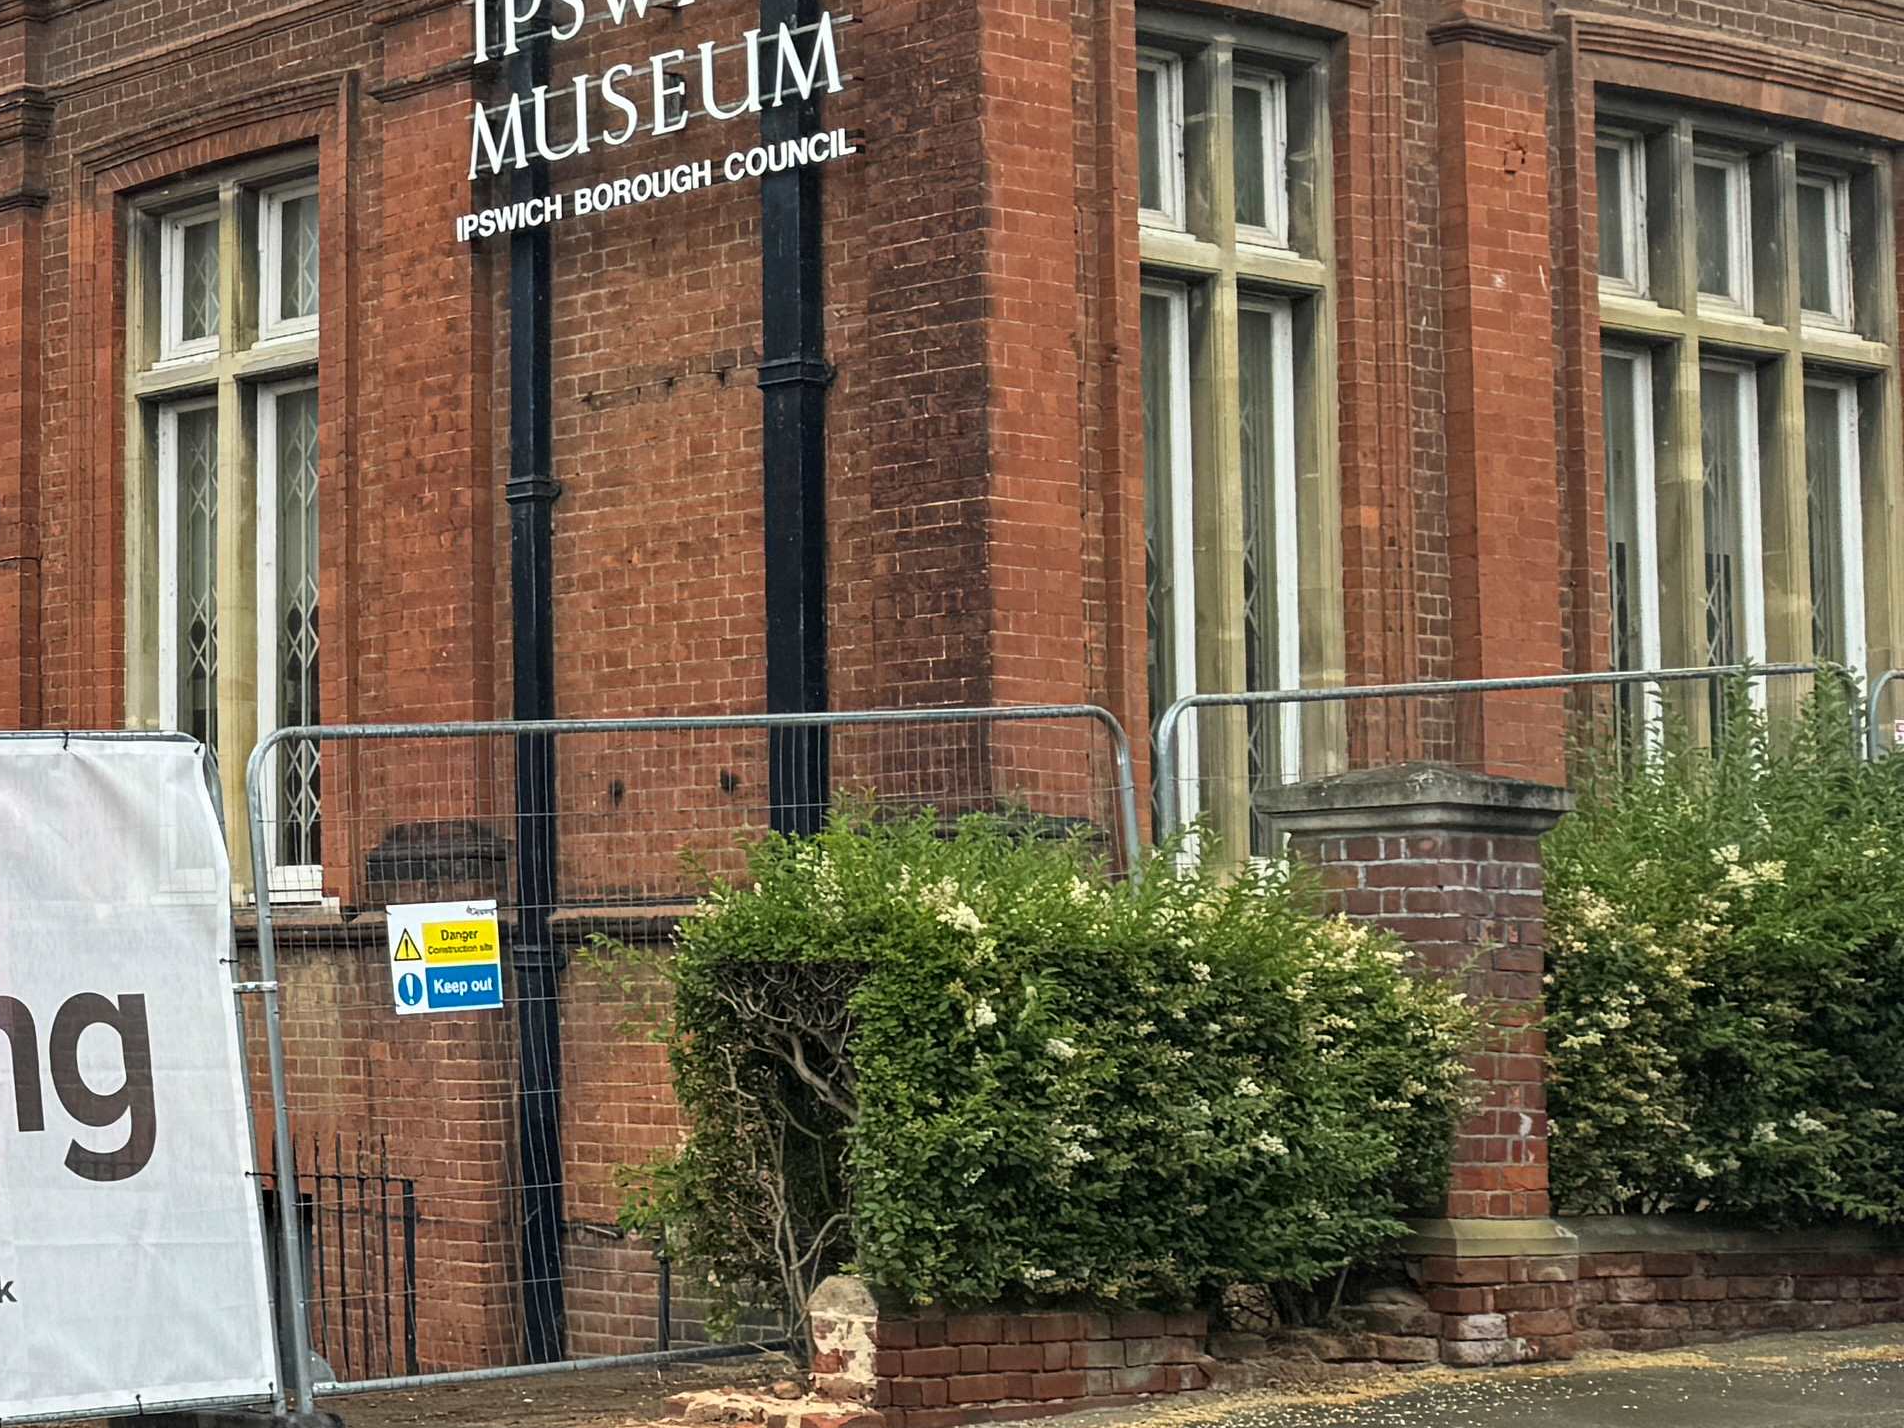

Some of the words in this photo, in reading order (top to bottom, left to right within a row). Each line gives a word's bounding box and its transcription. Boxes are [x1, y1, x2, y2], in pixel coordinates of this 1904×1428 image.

[466, 10, 845, 181] MUSEUM
[456, 193, 563, 243] IPSWICH
[574, 160, 713, 217] BOROUGH
[724, 127, 857, 183] COUNCIL
[440, 929, 479, 943] Danger
[433, 979, 468, 996] Keep
[471, 977, 493, 992] out
